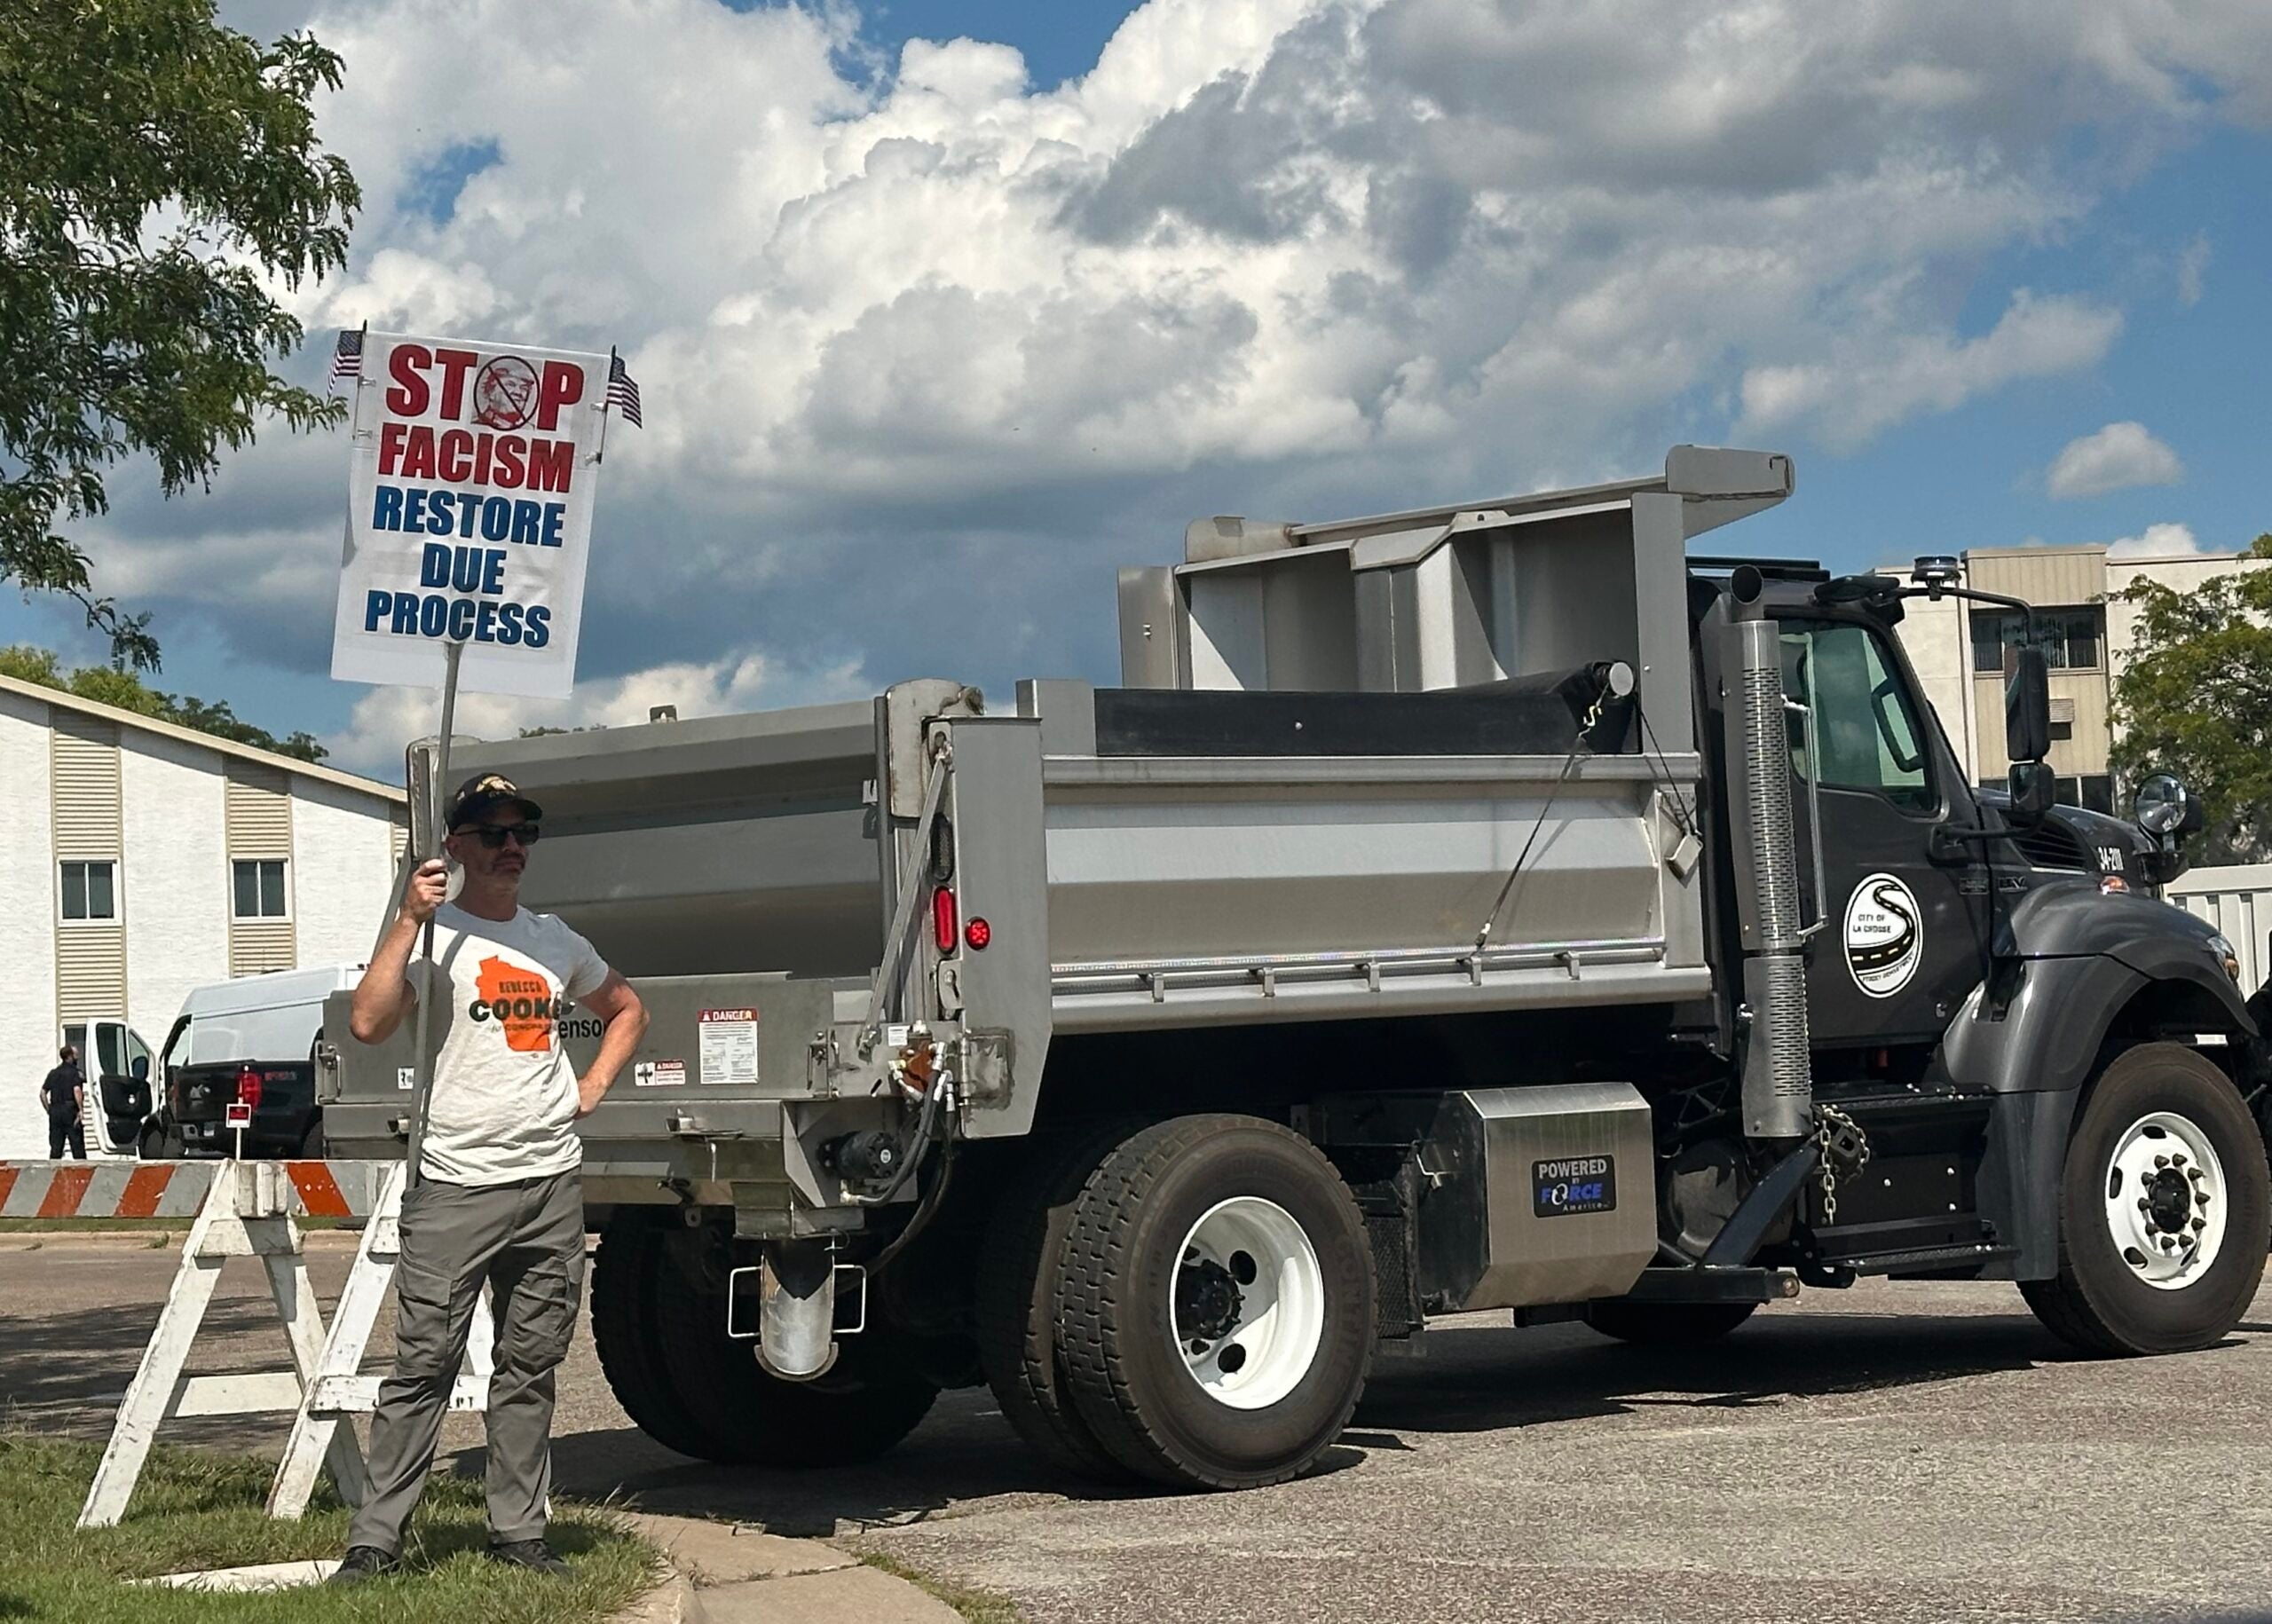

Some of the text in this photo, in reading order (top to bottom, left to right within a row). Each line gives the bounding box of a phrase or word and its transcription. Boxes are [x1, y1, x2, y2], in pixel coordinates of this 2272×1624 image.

[377, 422, 575, 493] FACISM
[372, 485, 566, 548] RESTORE
[420, 542, 508, 595] DUE
[365, 589, 551, 649] PROCESS
[1858, 913, 1886, 922] CITY OF
[713, 1009, 753, 1021] DANGER
[1538, 1158, 1607, 1179] POWERED
